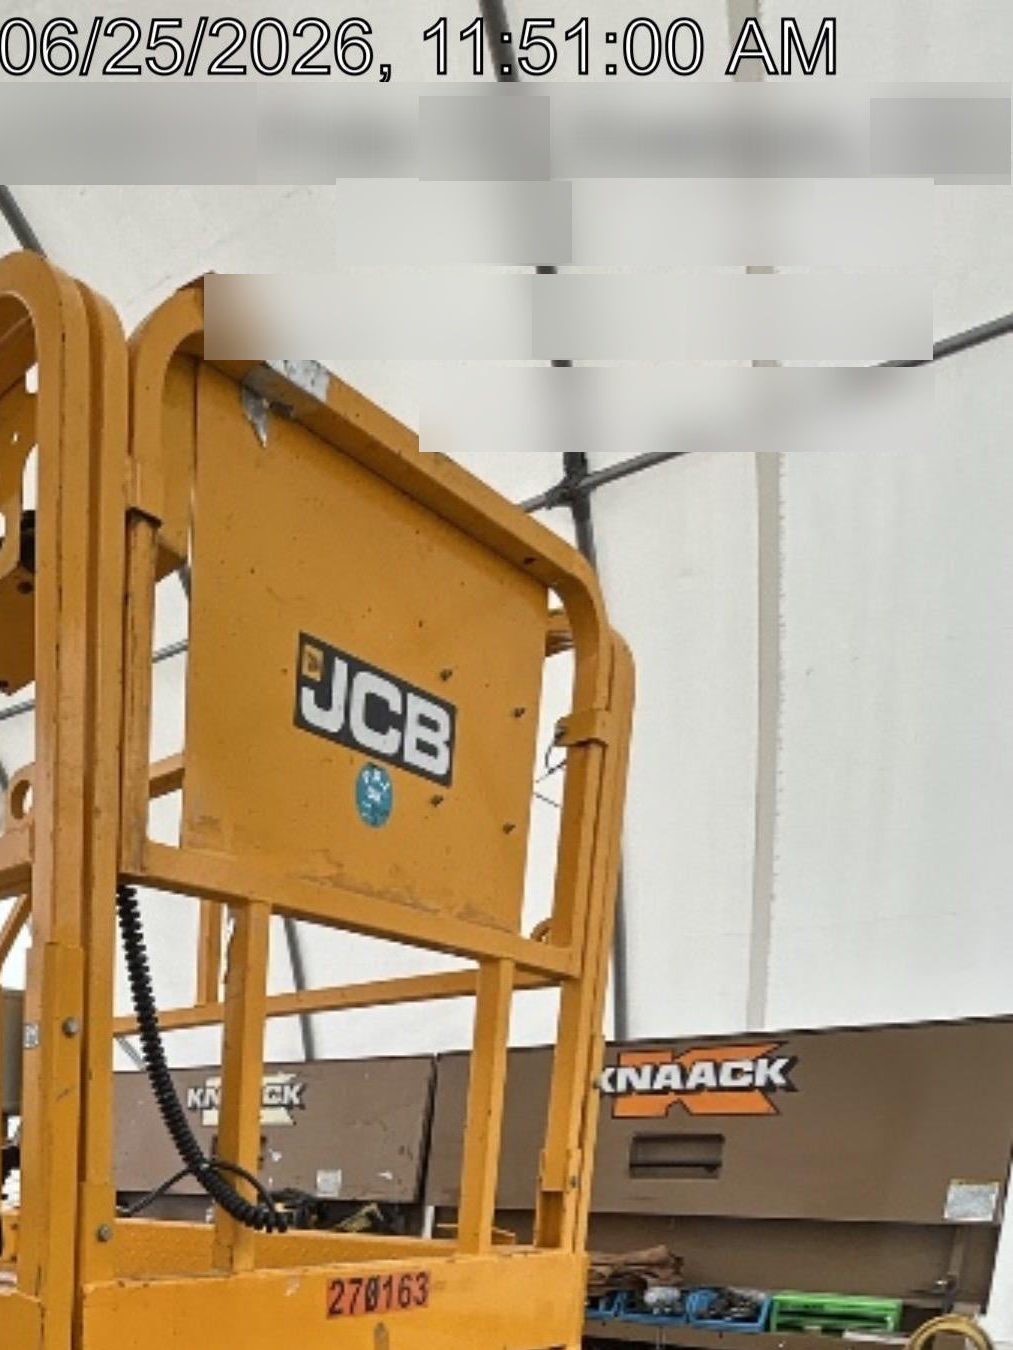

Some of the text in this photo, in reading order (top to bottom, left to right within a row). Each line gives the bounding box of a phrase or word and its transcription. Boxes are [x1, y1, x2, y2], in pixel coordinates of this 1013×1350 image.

[300, 656, 451, 776] JCB
[187, 1081, 303, 1109] KNCK
[328, 1271, 429, 1315] 270163
